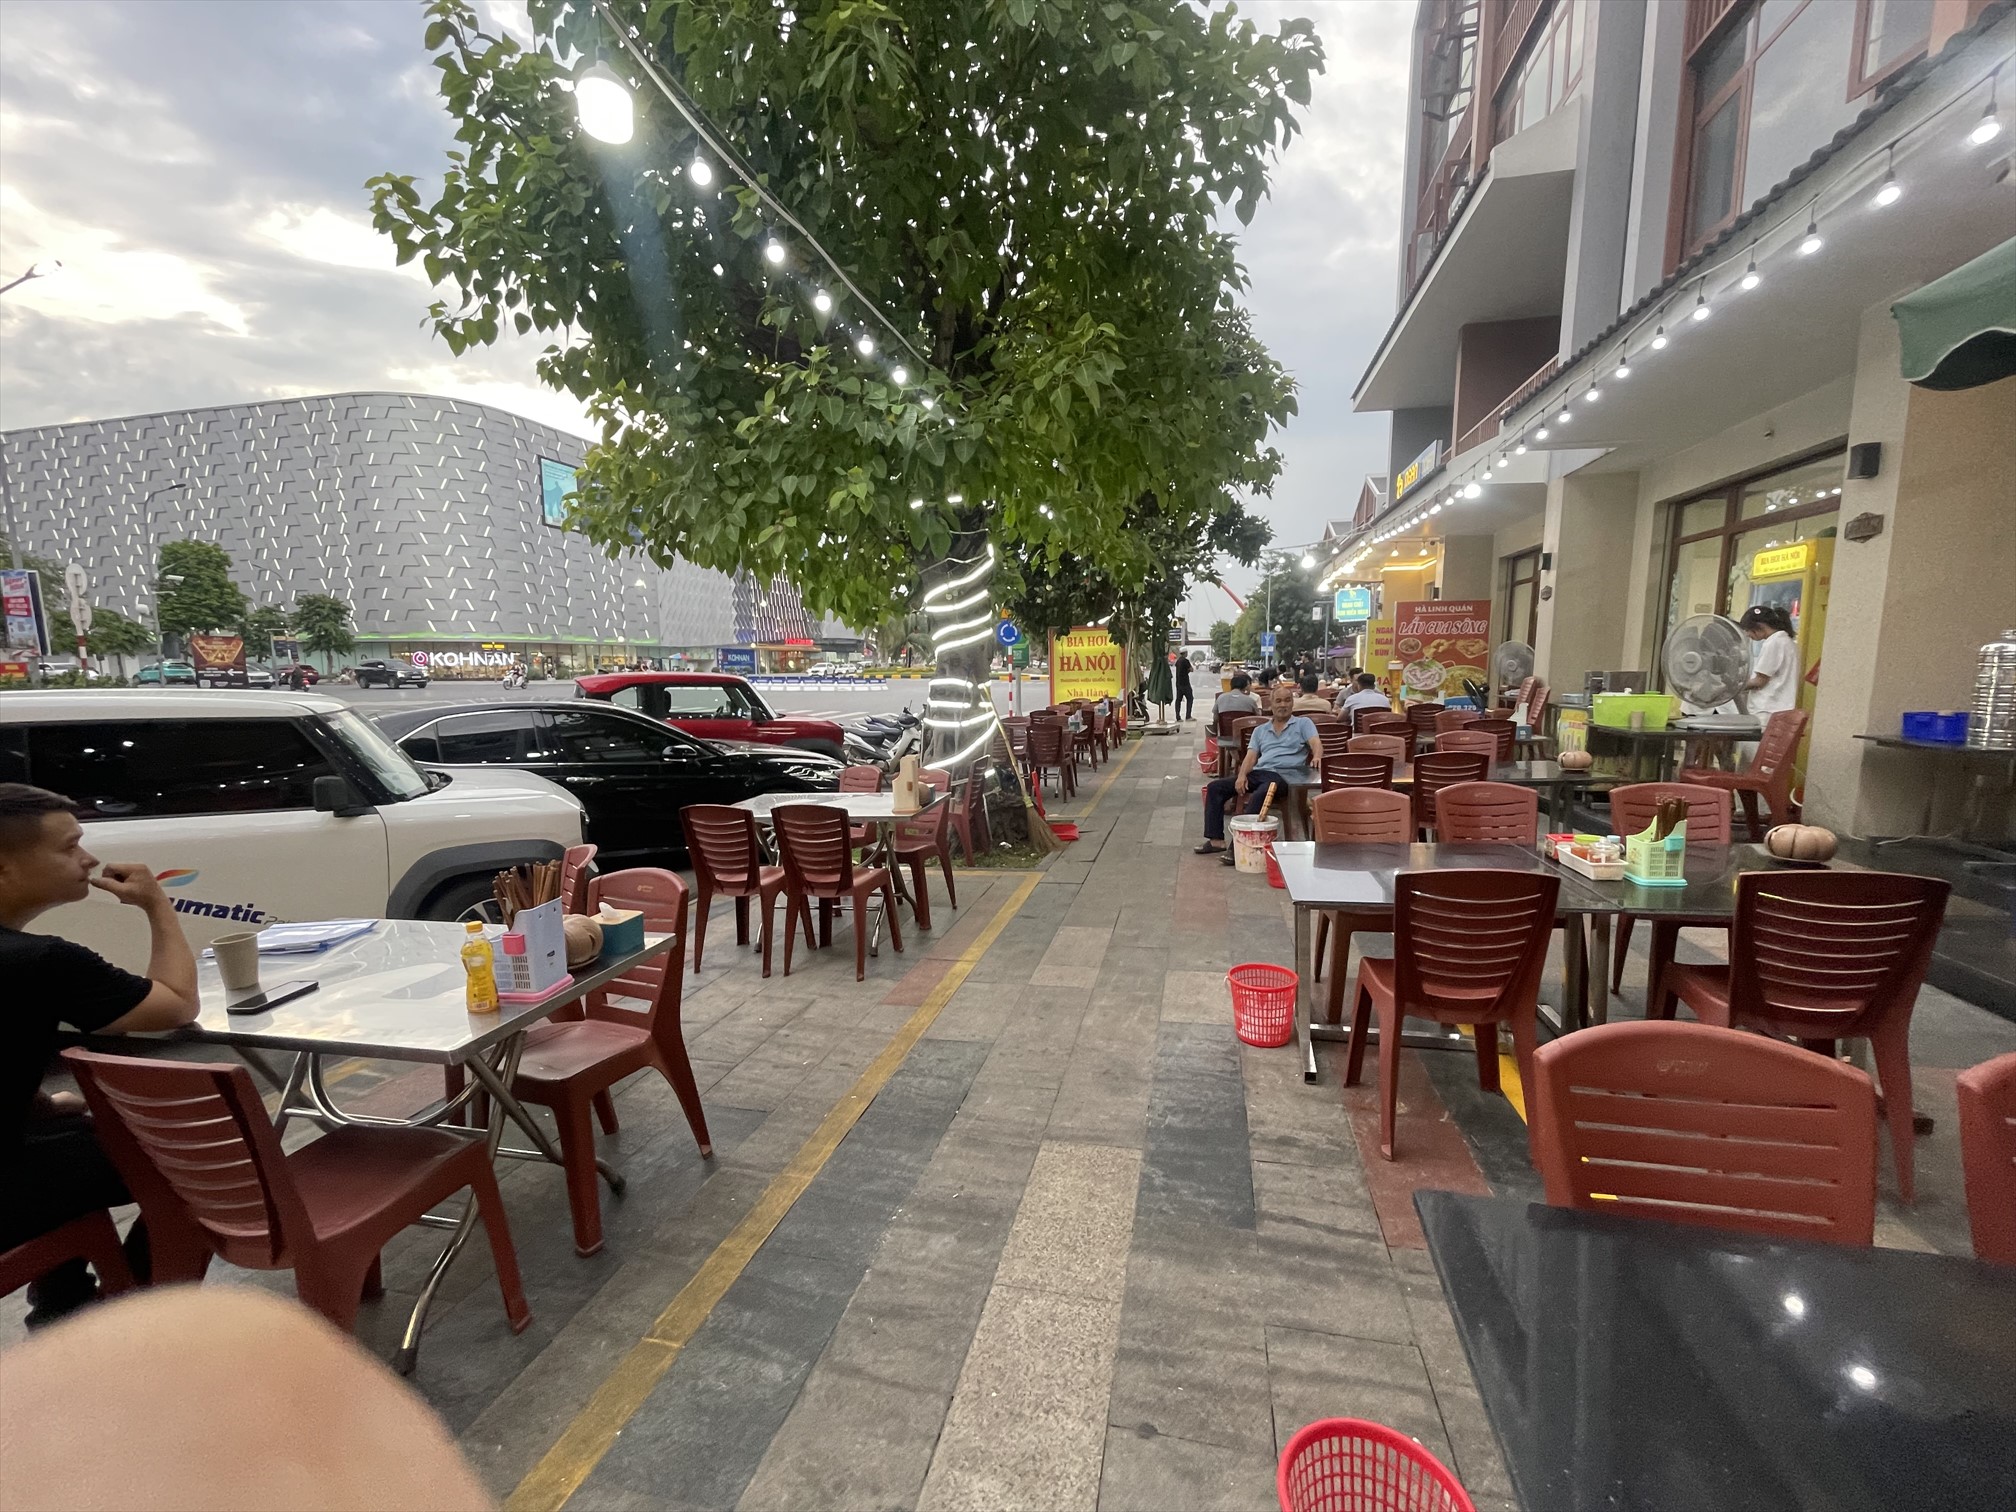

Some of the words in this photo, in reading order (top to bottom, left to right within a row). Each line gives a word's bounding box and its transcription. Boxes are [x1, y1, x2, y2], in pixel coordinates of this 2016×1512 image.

[1415, 605, 1427, 613] HÀ
[1425, 620, 1452, 635] CUA
[1451, 617, 1488, 635] SÔNG
[1067, 636, 1084, 647] BIA
[429, 651, 515, 666] KOHNAN
[728, 653, 750, 662] KOHNAN
[1059, 652, 1083, 671] HÀ
[1085, 651, 1116, 675] NỘI
[1067, 688, 1083, 697] Nhà
